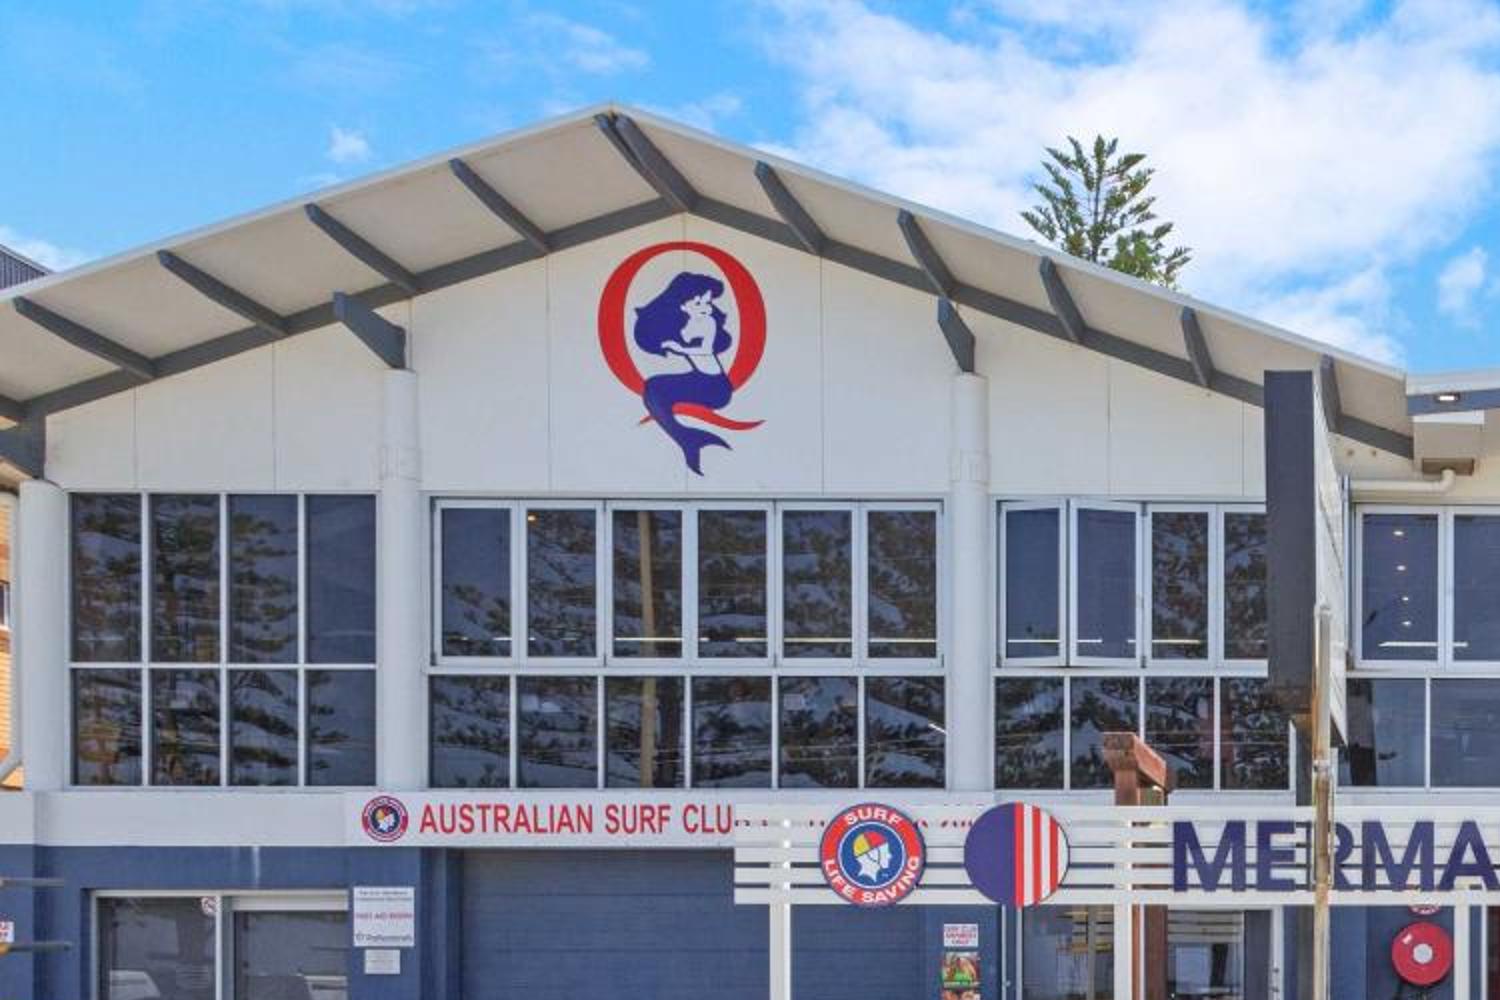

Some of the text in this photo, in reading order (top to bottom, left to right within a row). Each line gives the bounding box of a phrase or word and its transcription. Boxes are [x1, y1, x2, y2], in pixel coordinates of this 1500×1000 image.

[419, 804, 593, 834] AUSTRALIAN
[605, 804, 671, 834] SURF
[682, 804, 733, 834] CLU
[845, 807, 902, 825] SURF
[824, 856, 919, 902] LIFE SAVING
